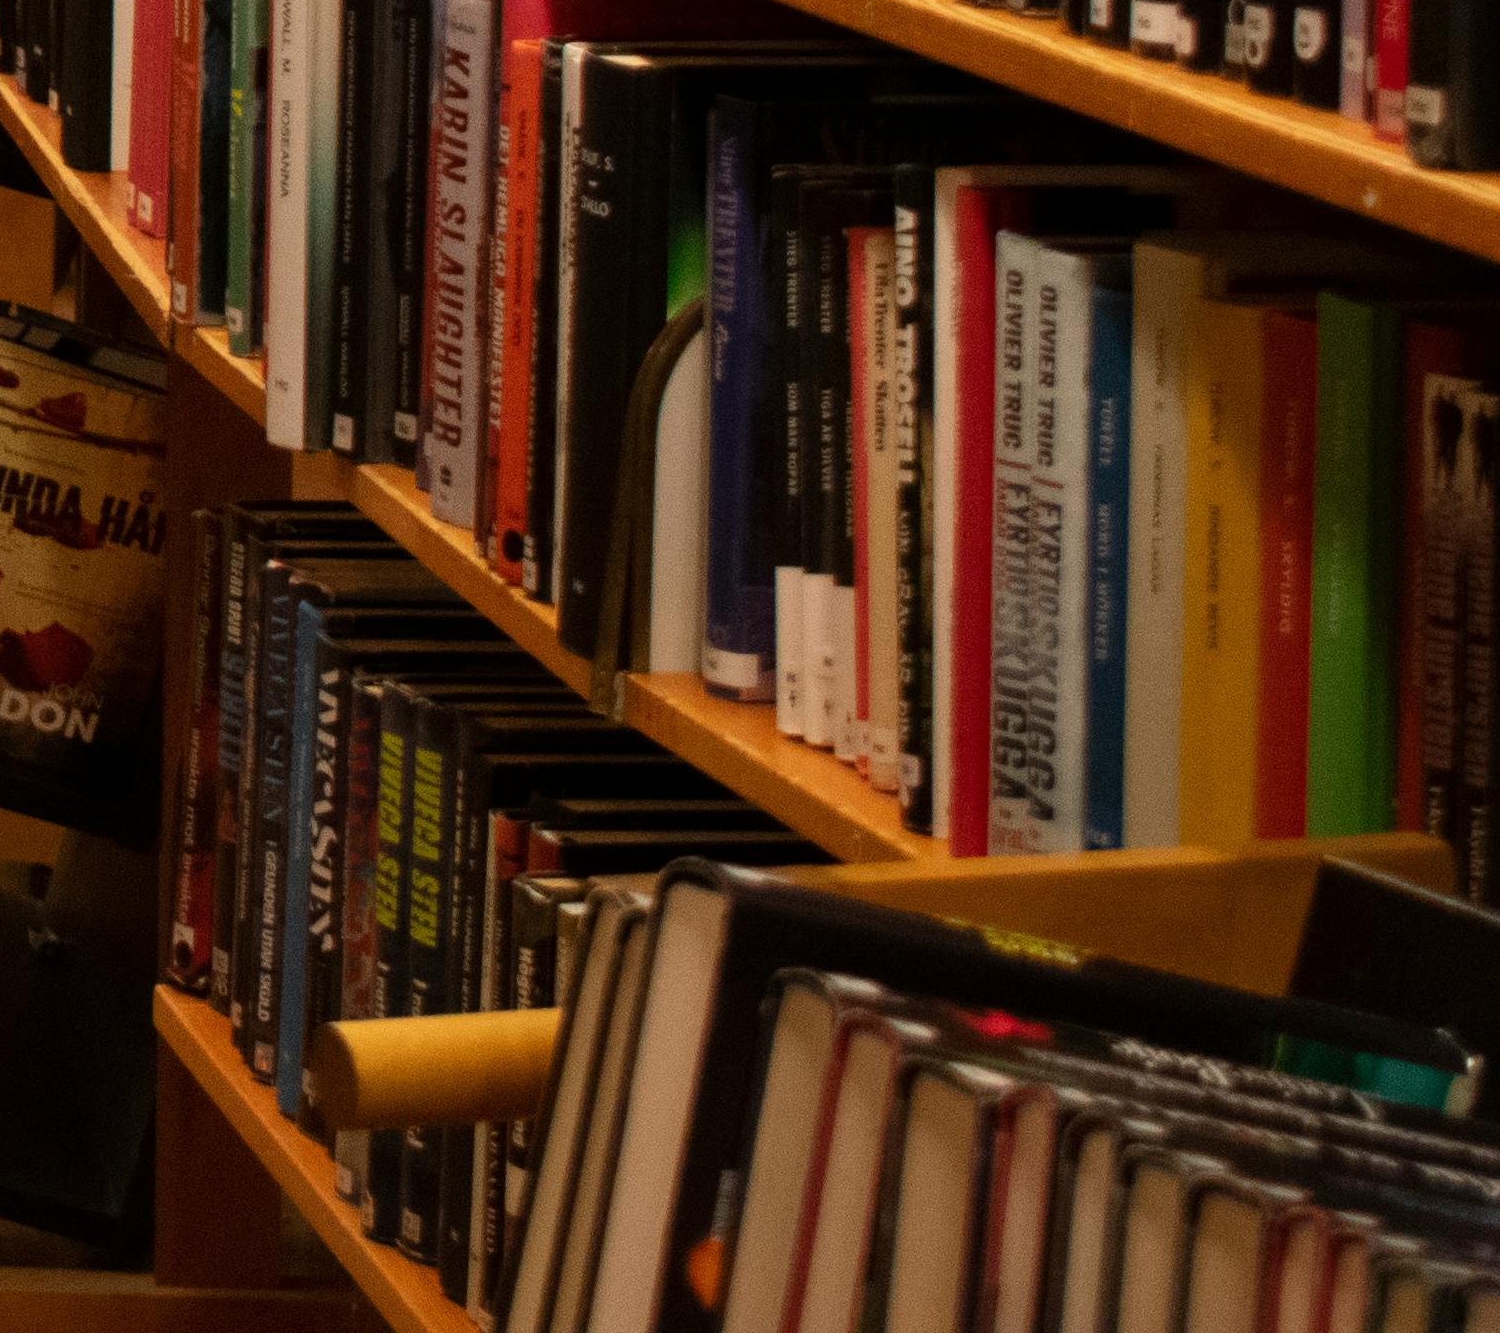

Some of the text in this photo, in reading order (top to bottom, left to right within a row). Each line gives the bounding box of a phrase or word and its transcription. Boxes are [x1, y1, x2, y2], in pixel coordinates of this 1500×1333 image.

[278, 99, 292, 198] ROSEANNA
[430, 49, 472, 448] KARIN SLAUGHTER
[1003, 269, 1025, 450] OLIVIER TRUC
[1036, 284, 1060, 467] OLIVIER TRUC
[407, 748, 443, 948] VIVECA STEN
